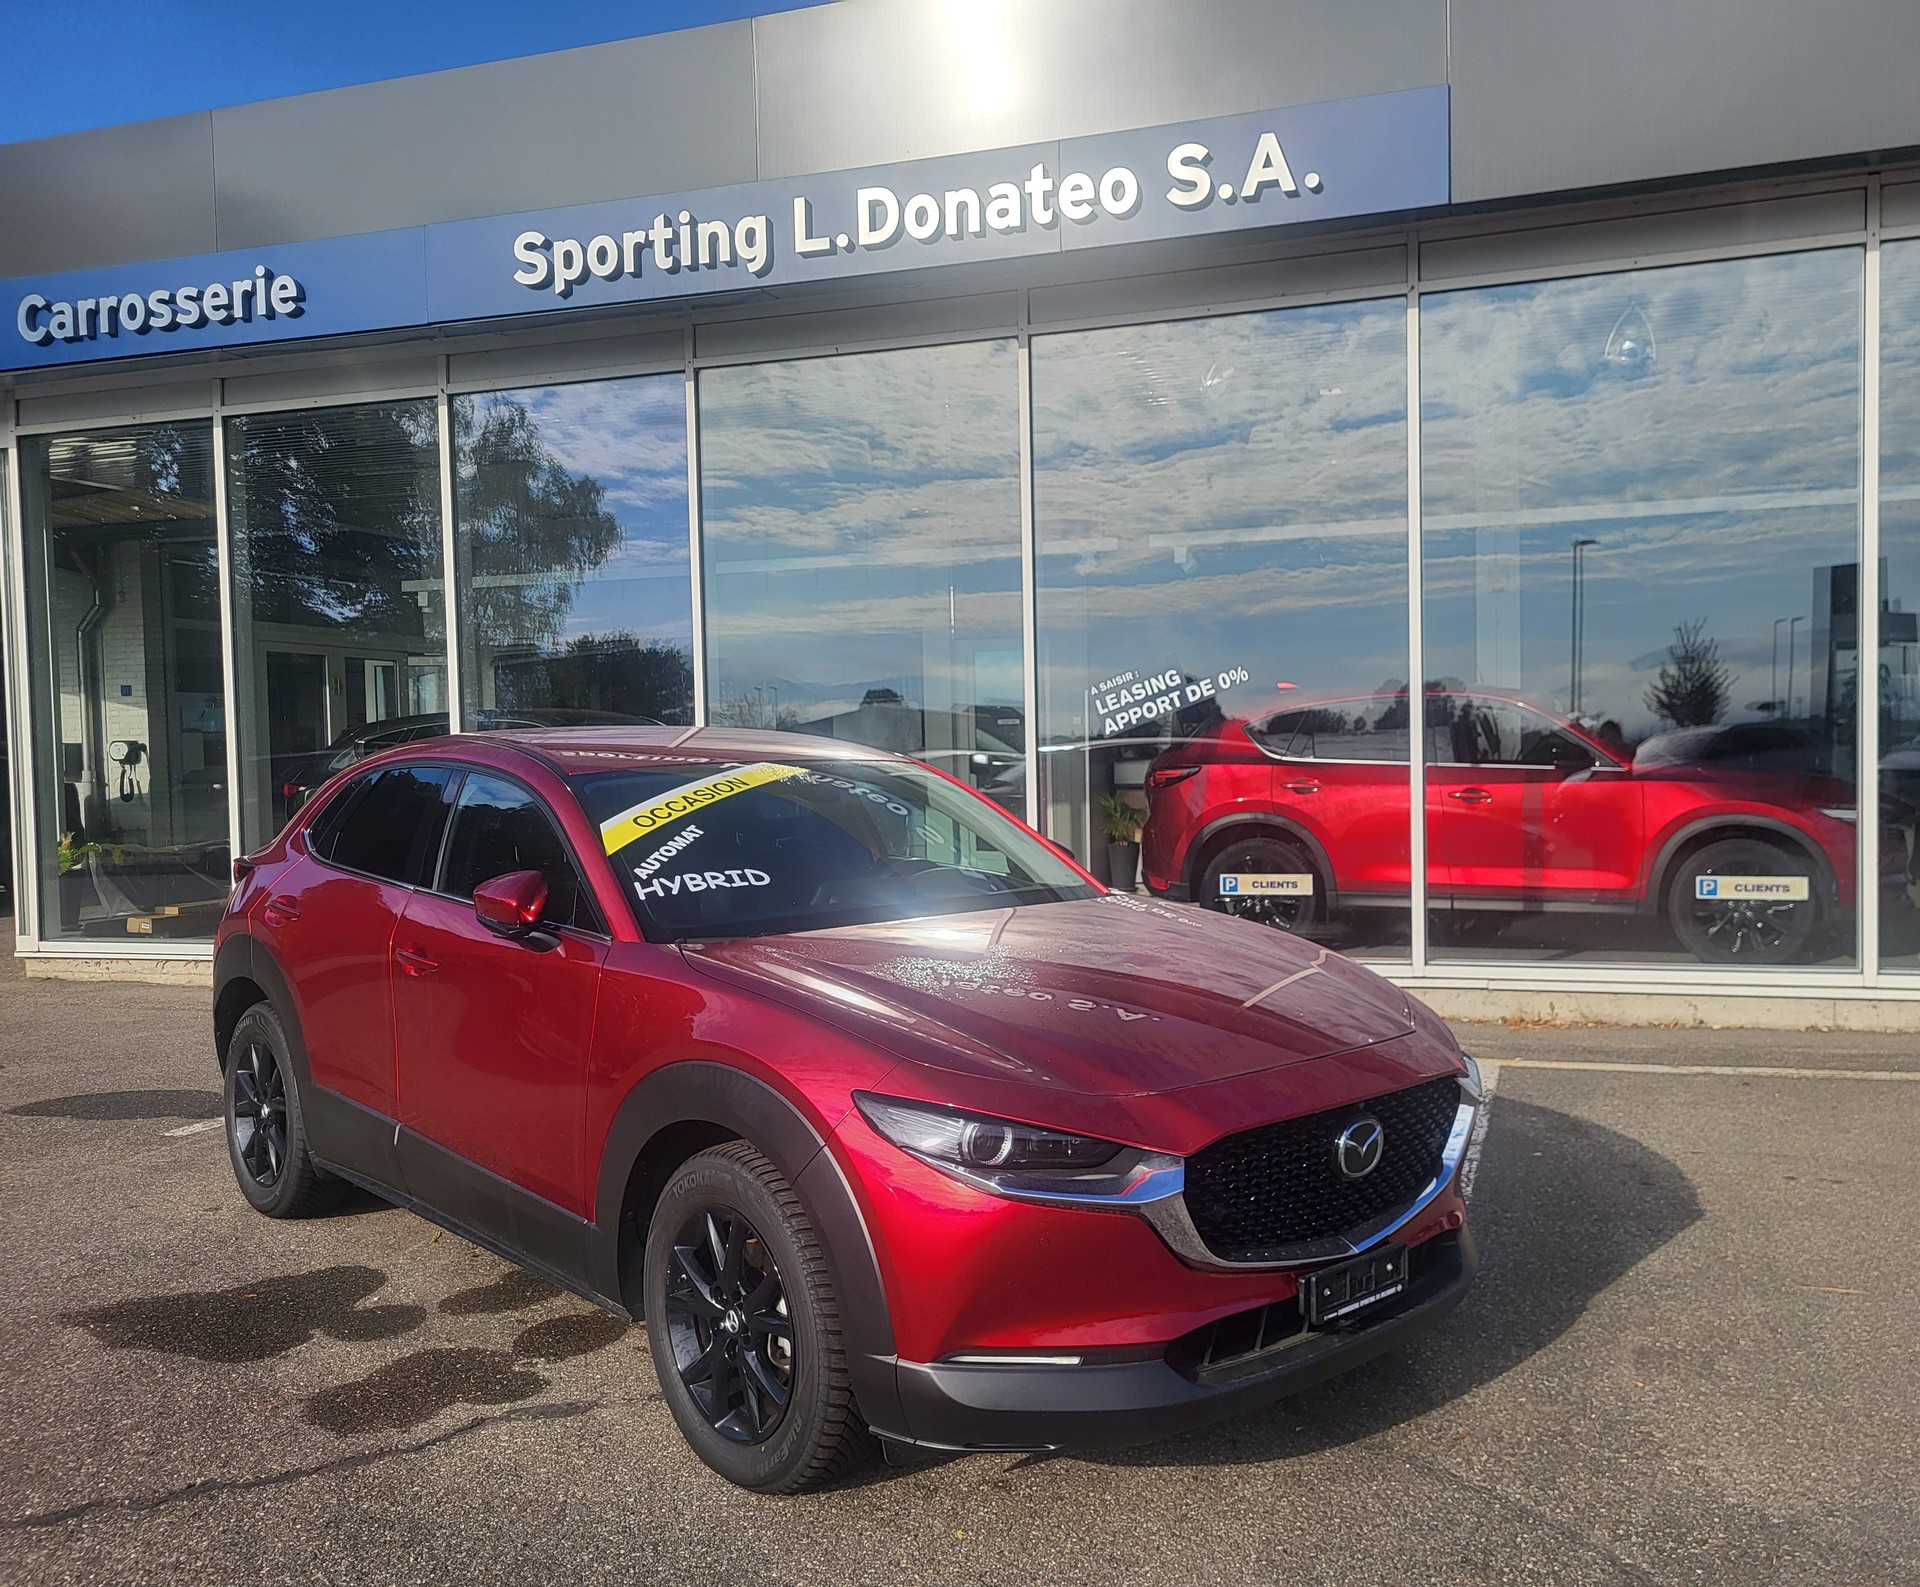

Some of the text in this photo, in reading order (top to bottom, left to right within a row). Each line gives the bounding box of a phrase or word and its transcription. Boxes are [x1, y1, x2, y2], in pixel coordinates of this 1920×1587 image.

[513, 132, 1322, 298] Sporting L.Donateo S.A.
[17, 264, 303, 345] Carrosserie
[1094, 669, 1182, 715] LEASING
[1099, 671, 1134, 692] SAISIR
[1104, 665, 1249, 735] APPORT DE 0%
[632, 776, 751, 828] OCCASION
[633, 824, 704, 880] AUTOMAT
[633, 868, 771, 901] HYBRID
[1251, 880, 1298, 889] CLIENTS
[1734, 883, 1791, 893] CLIENTS
